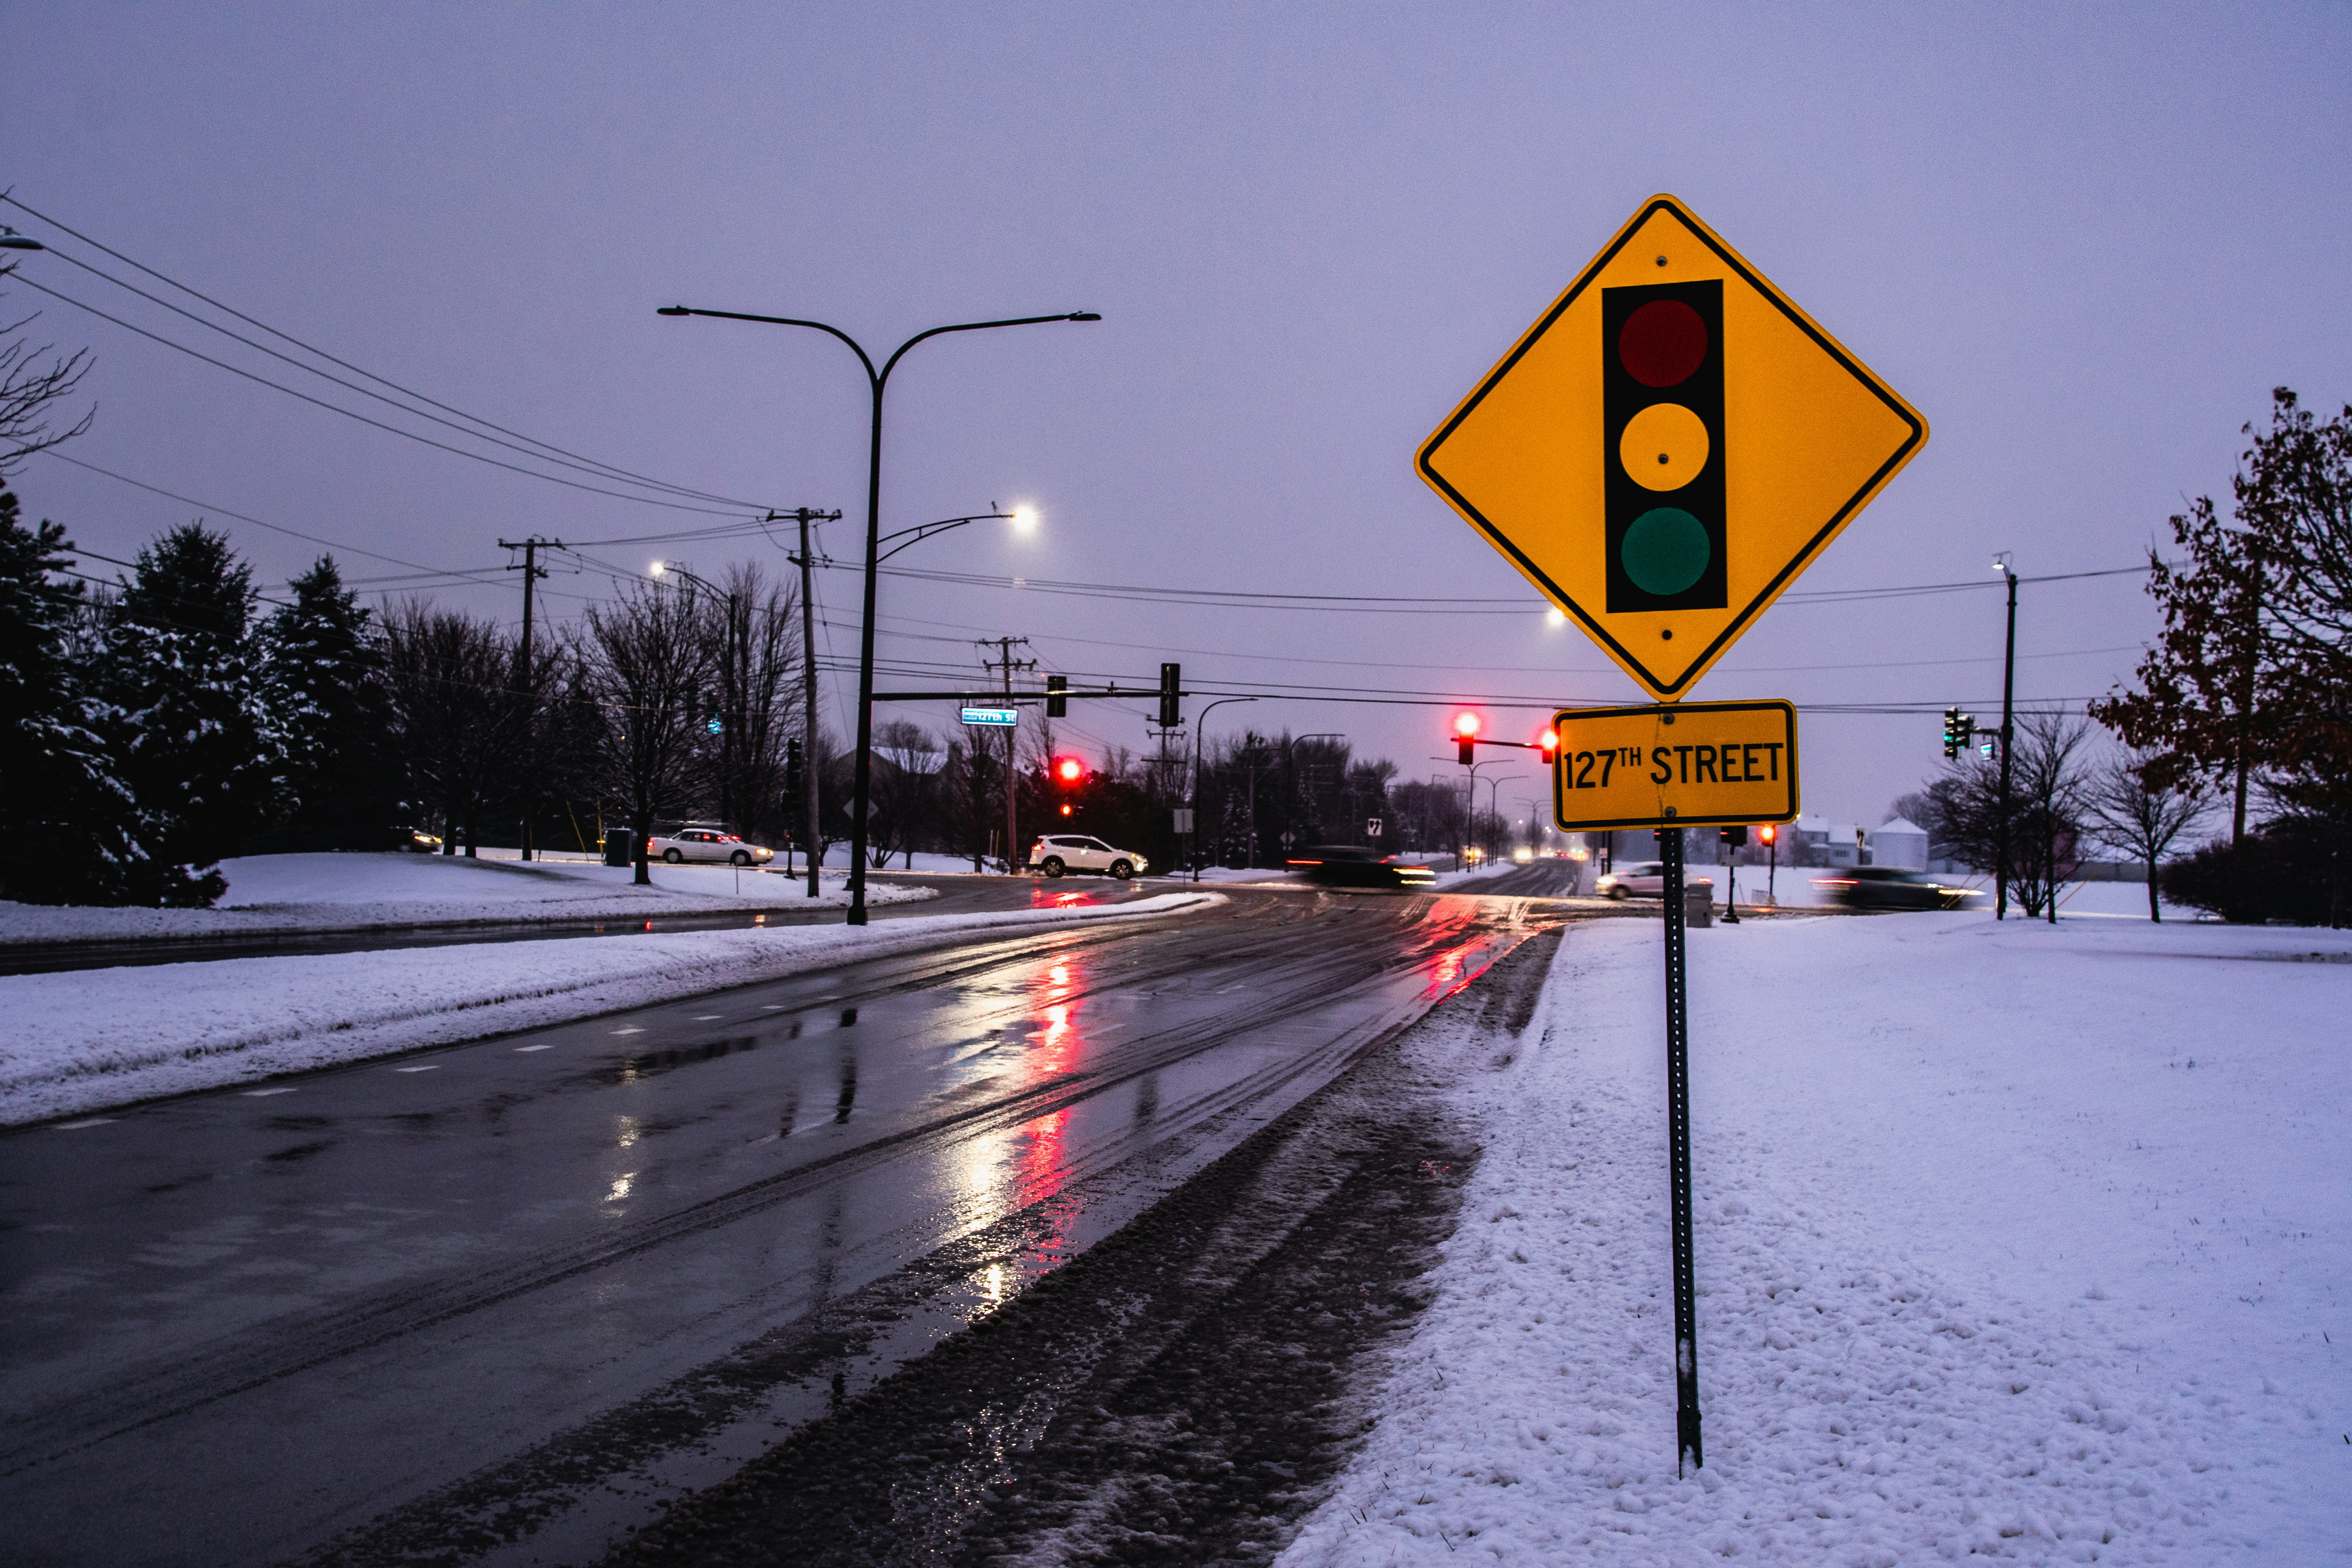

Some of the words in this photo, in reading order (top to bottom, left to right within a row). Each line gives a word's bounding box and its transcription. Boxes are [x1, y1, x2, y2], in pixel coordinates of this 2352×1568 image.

[977, 712, 1002, 721] 127th
[1564, 746, 1641, 789] 127TH
[1650, 743, 1783, 784] STREET
